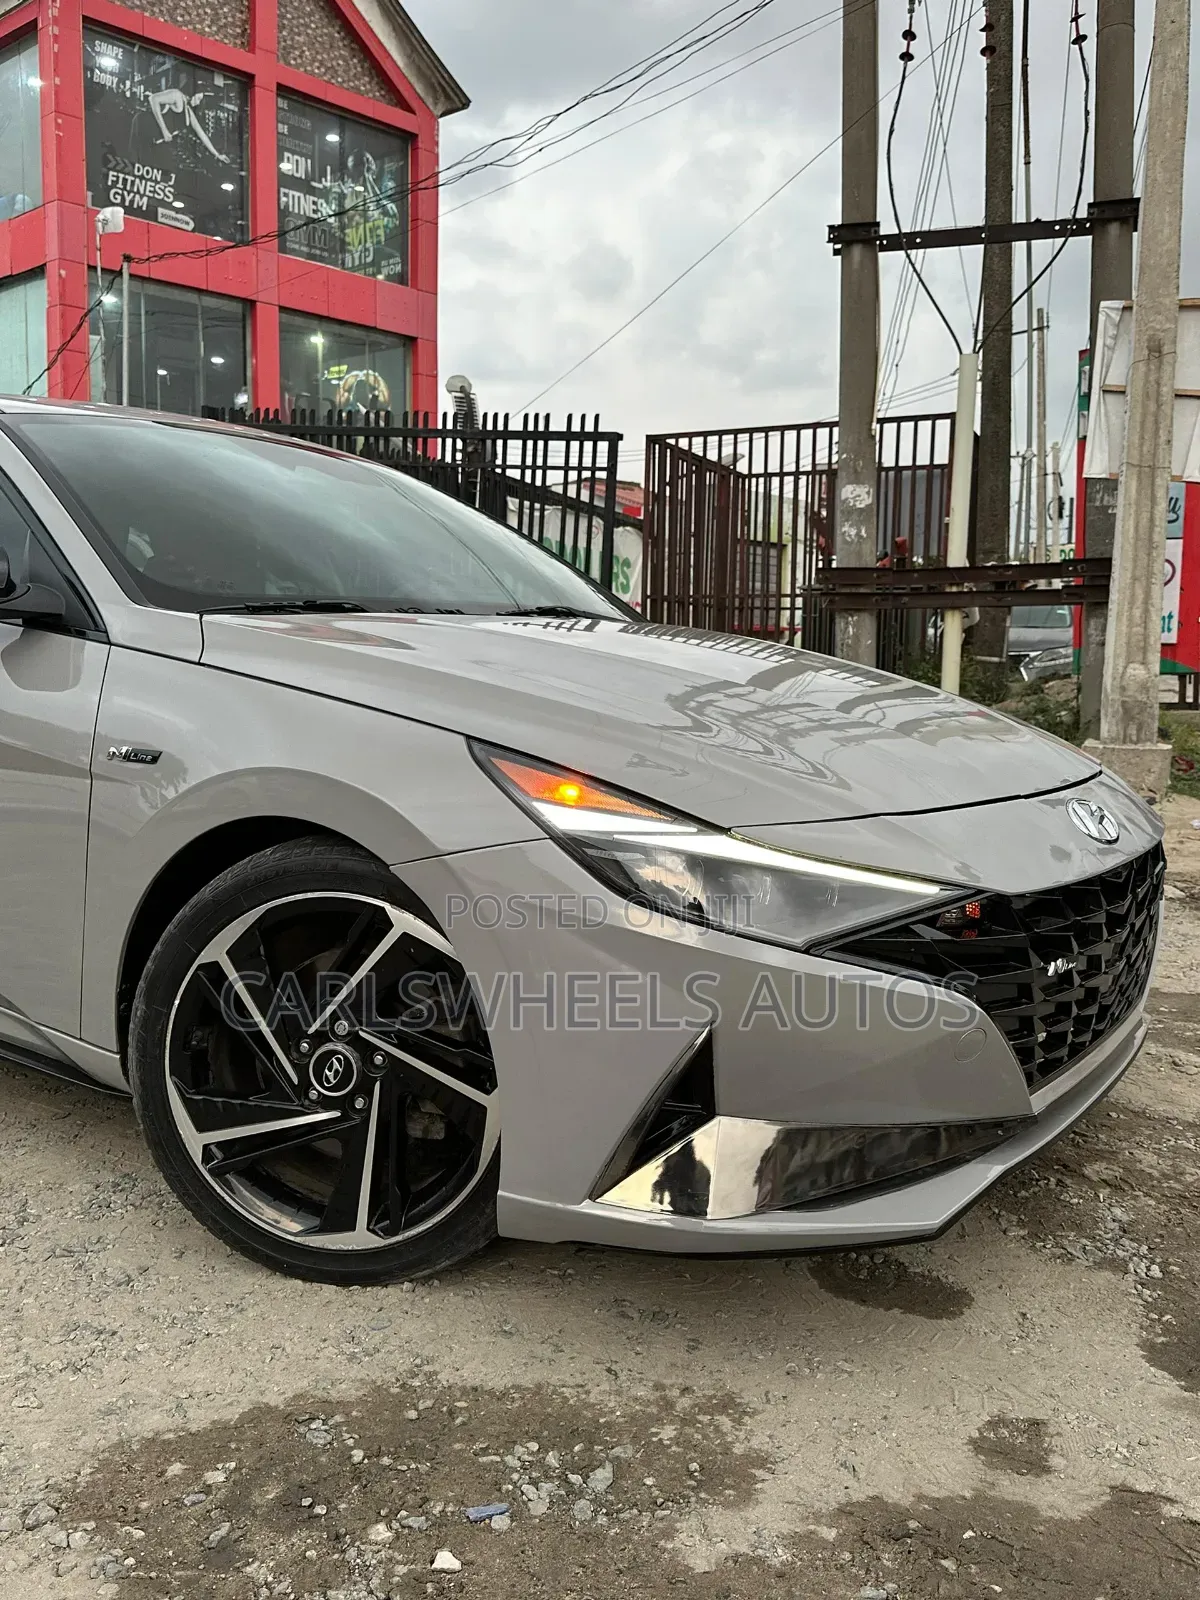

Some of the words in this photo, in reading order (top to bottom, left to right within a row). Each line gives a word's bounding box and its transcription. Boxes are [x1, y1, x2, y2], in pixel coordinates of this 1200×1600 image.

[94, 40, 124, 59] SHAPE
[93, 70, 118, 90] BODY
[107, 170, 175, 202] FITNESS
[109, 188, 149, 211] GYM
